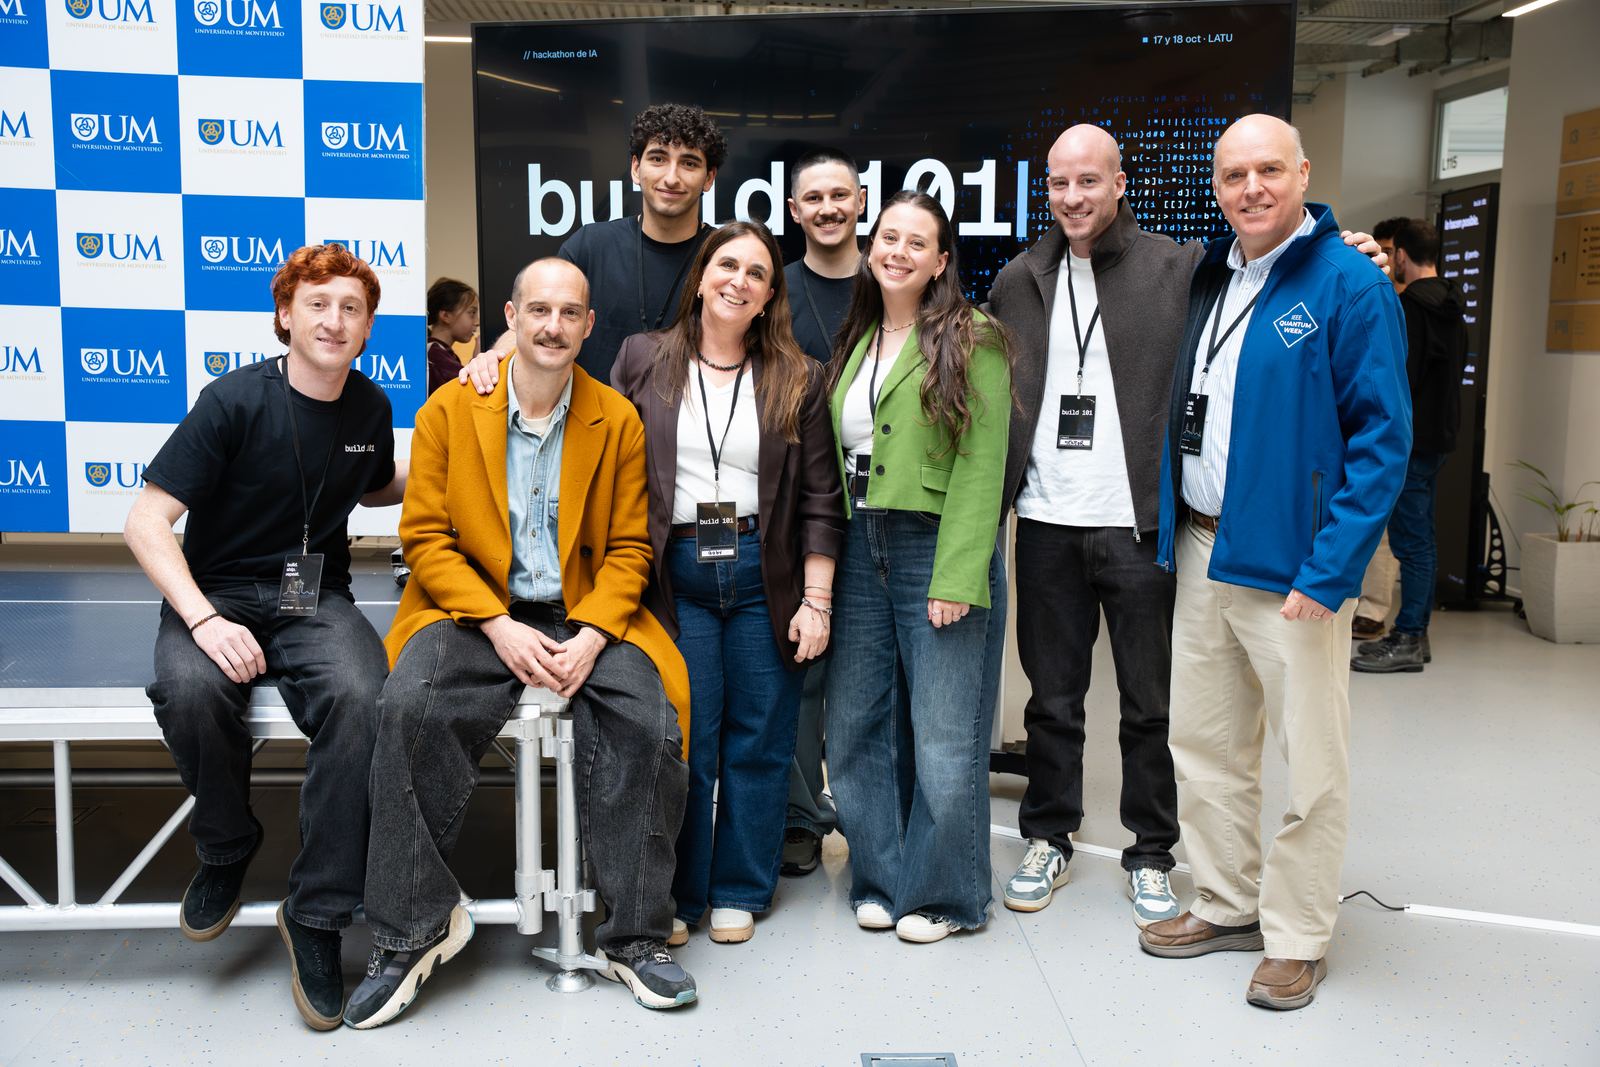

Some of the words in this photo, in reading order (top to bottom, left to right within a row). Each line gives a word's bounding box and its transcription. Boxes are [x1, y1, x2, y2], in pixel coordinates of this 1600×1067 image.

[97, 0, 157, 23] UM
[227, 0, 283, 28] UM
[350, 4, 408, 32] UM
[1153, 35, 1163, 44] 17
[1164, 36, 1171, 45] y
[1173, 35, 1183, 44] 18
[1185, 34, 1201, 43] oct
[1208, 33, 1233, 43] LATU
[532, 50, 575, 59] hackathon
[576, 49, 587, 58] de
[588, 49, 598, 58] IA
[101, 115, 162, 144] UM
[228, 120, 286, 147] UM
[350, 123, 408, 151] UM
[528, 161, 784, 236] buld
[107, 233, 166, 261] UM
[230, 237, 287, 264] UM
[1279, 320, 1311, 329] QUANTUM
[110, 349, 168, 376] UM
[344, 444, 366, 453] build
